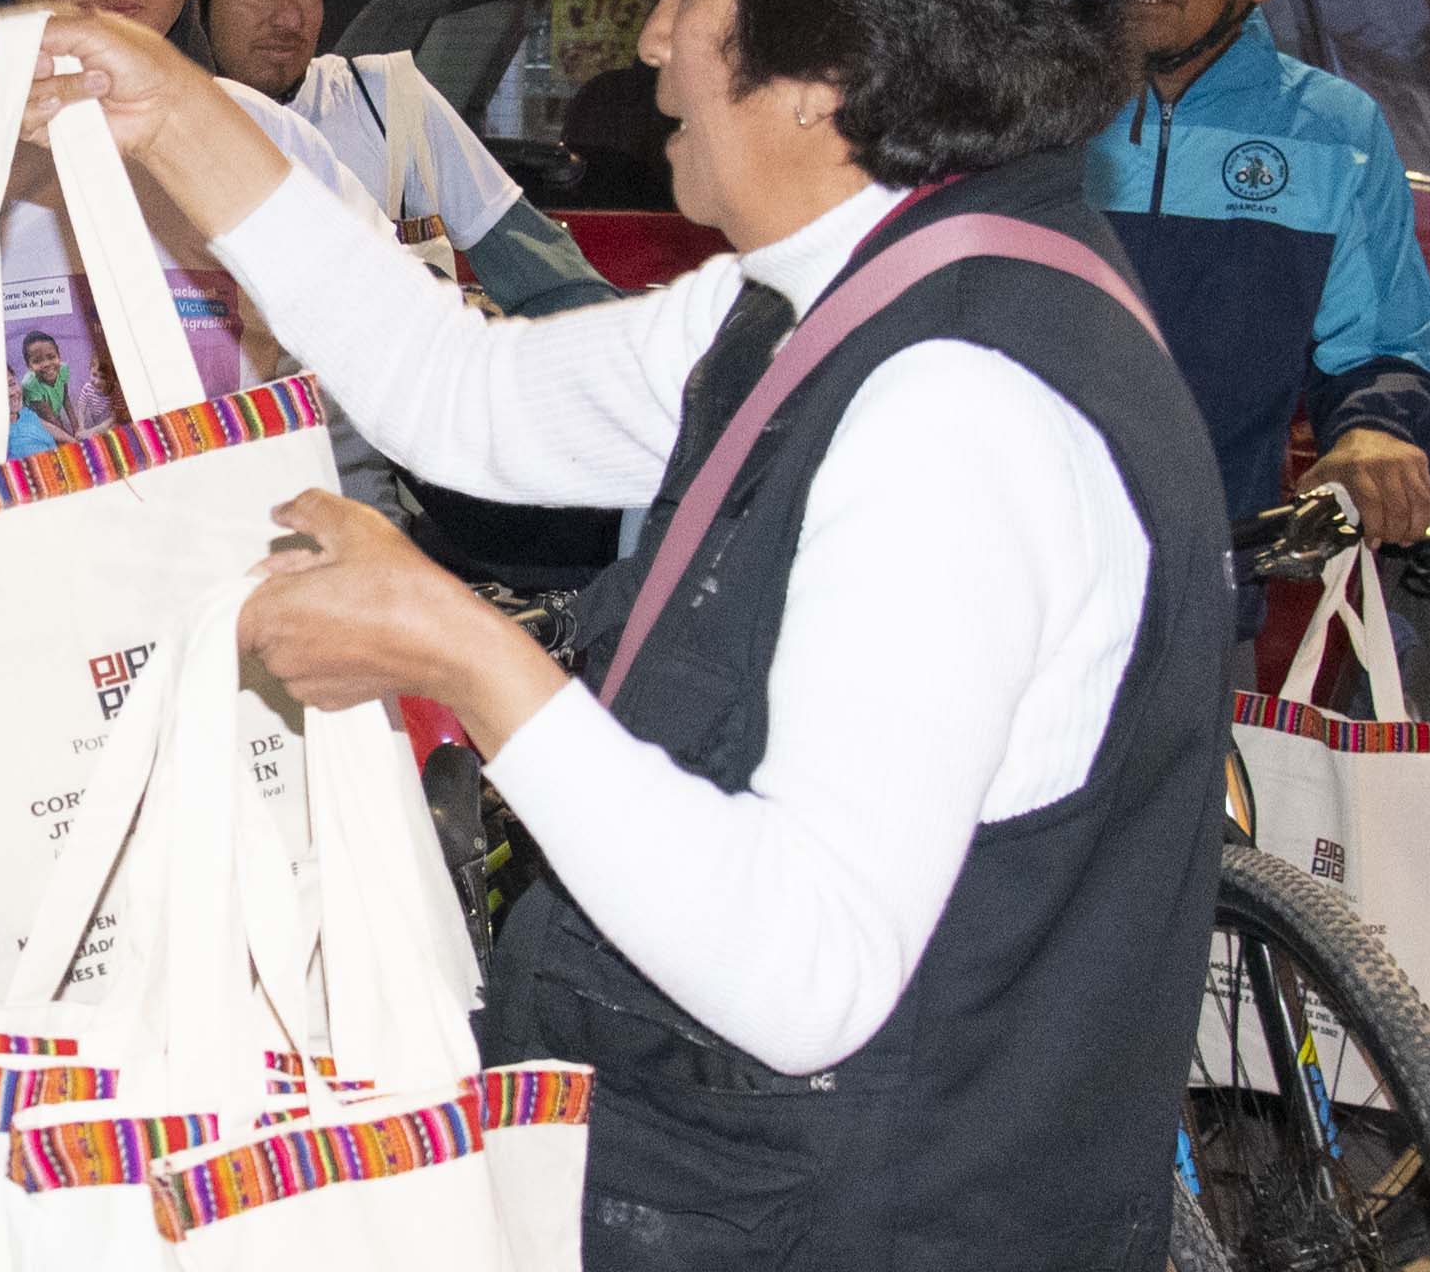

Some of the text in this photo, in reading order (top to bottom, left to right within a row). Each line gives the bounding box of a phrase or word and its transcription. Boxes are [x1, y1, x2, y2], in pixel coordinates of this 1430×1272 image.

[23, 288, 54, 301] Superior
[3, 300, 28, 311] usticia
[31, 734, 284, 817] COR DE
